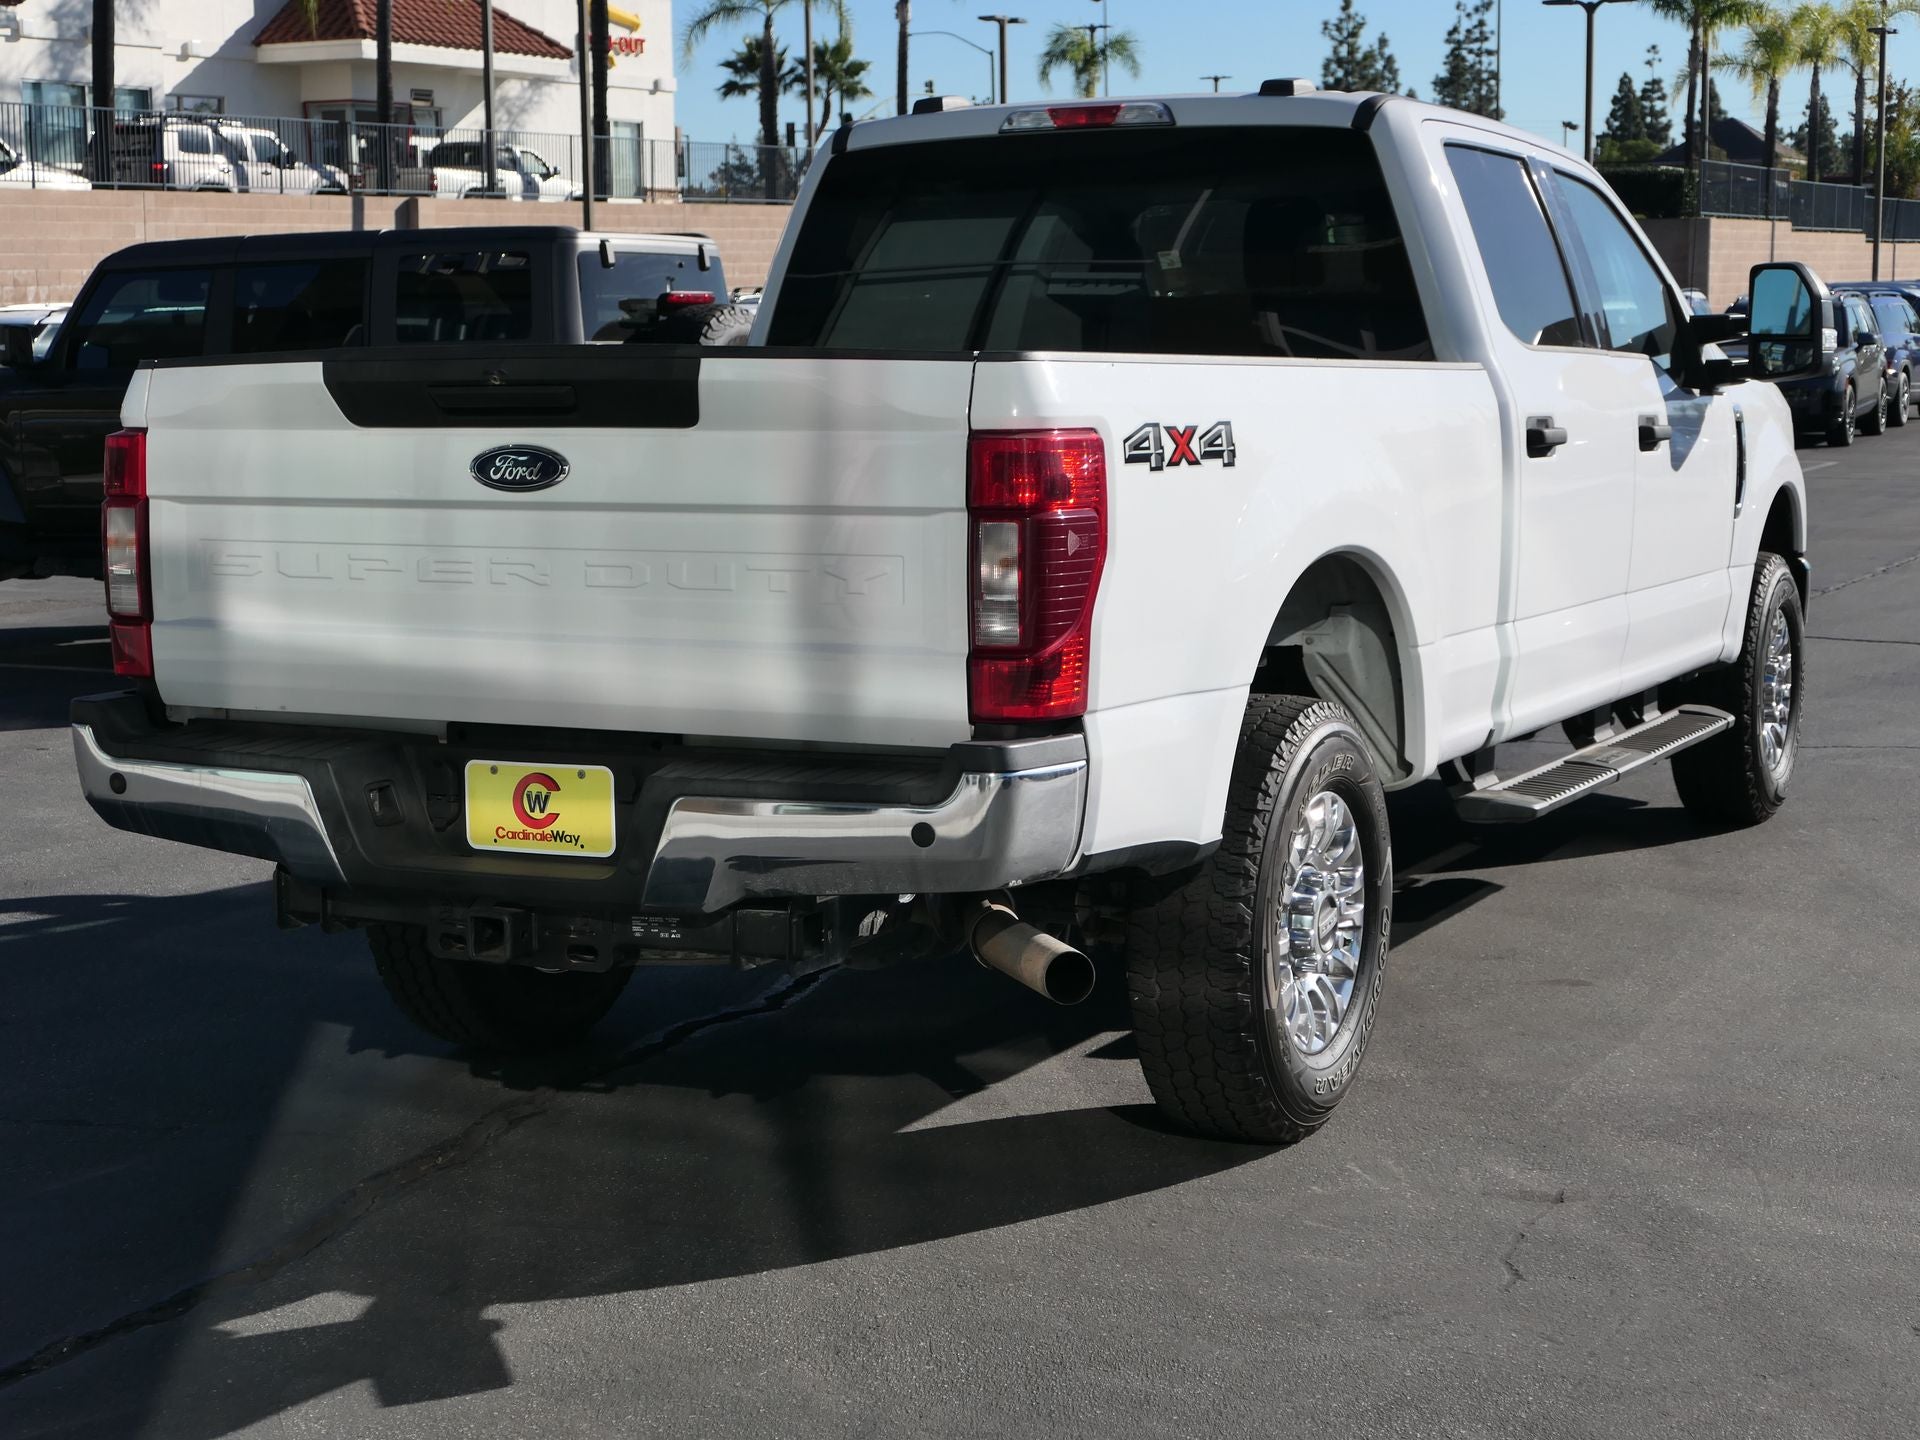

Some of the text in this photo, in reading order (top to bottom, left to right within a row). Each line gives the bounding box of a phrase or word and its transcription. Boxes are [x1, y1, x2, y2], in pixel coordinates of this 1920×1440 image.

[490, 454, 542, 480] Ford
[209, 549, 894, 598] SUPER DUTY
[495, 826, 581, 846] CardinaleWay
[1314, 905, 1392, 1095] GOODYEAR
